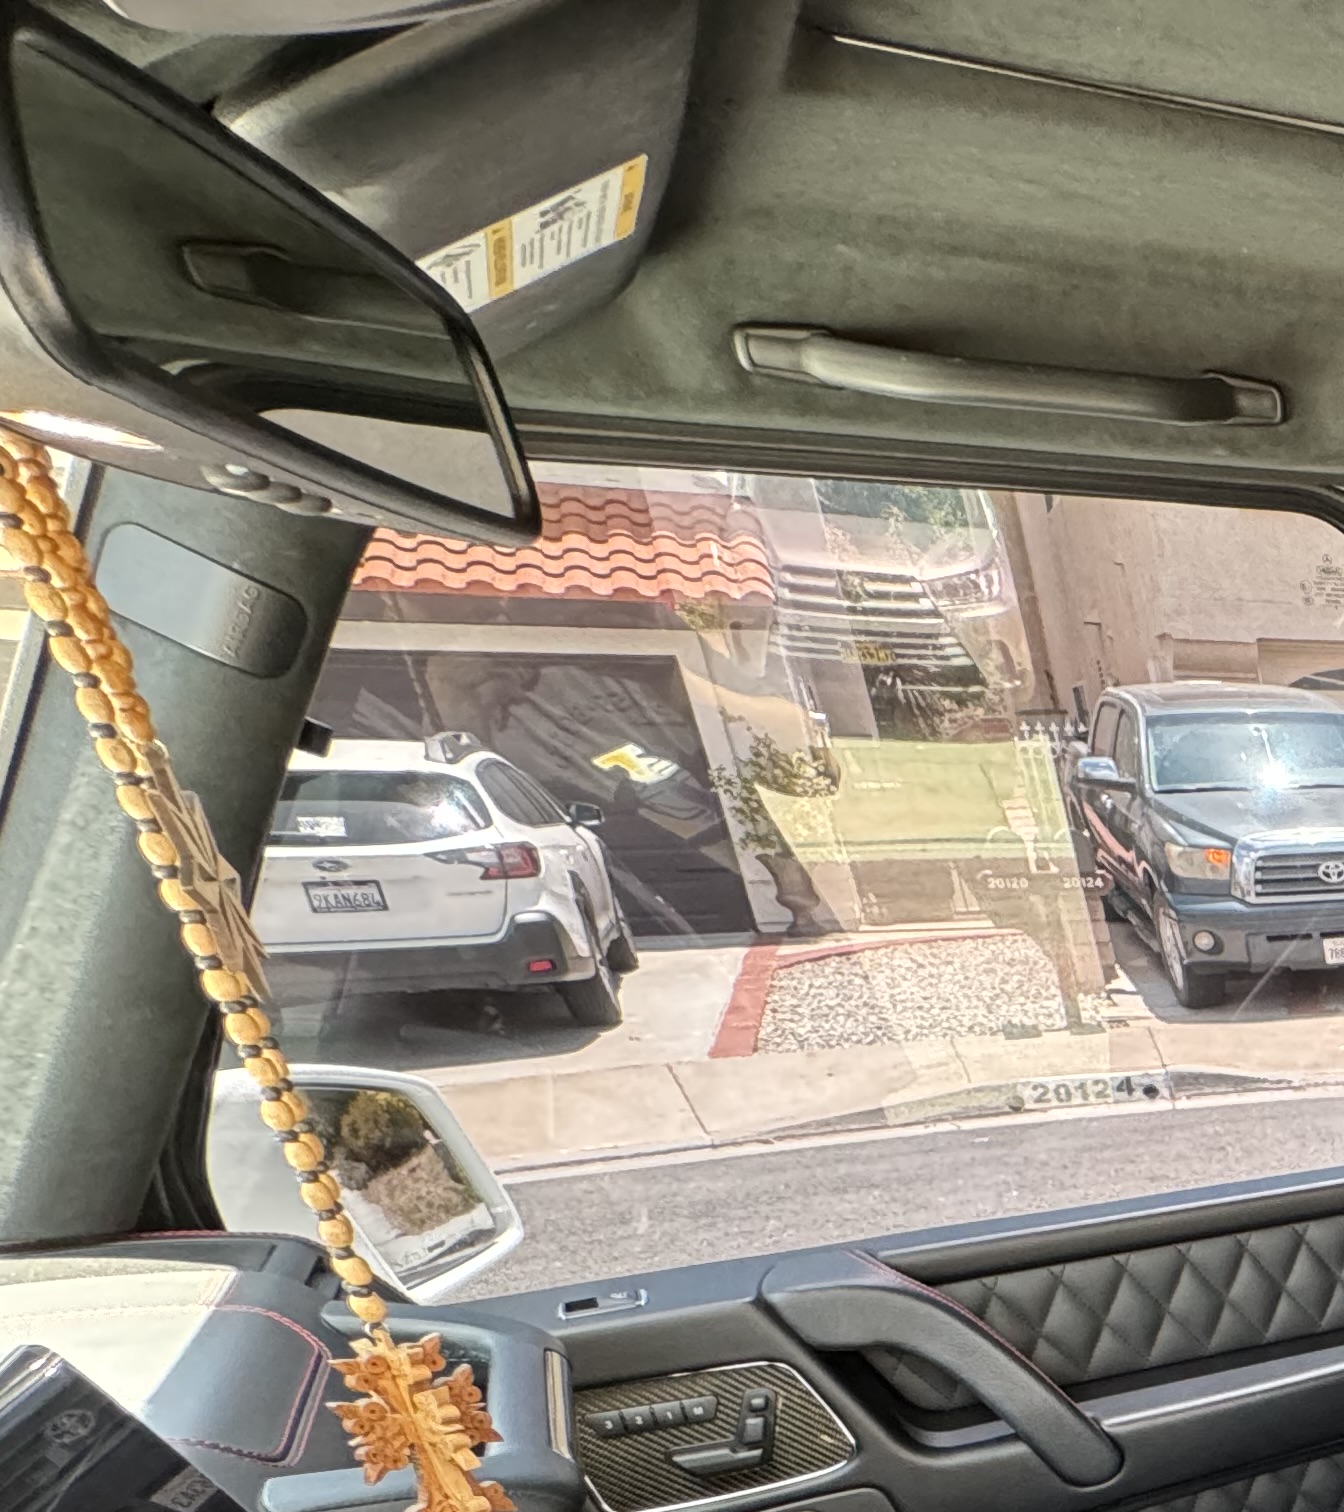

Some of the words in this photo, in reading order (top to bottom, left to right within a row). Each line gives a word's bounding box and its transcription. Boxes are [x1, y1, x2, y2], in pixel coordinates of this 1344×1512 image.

[987, 877, 1029, 889] 20120
[1063, 877, 1104, 889] 20124
[1031, 1076, 1135, 1103] 20124
